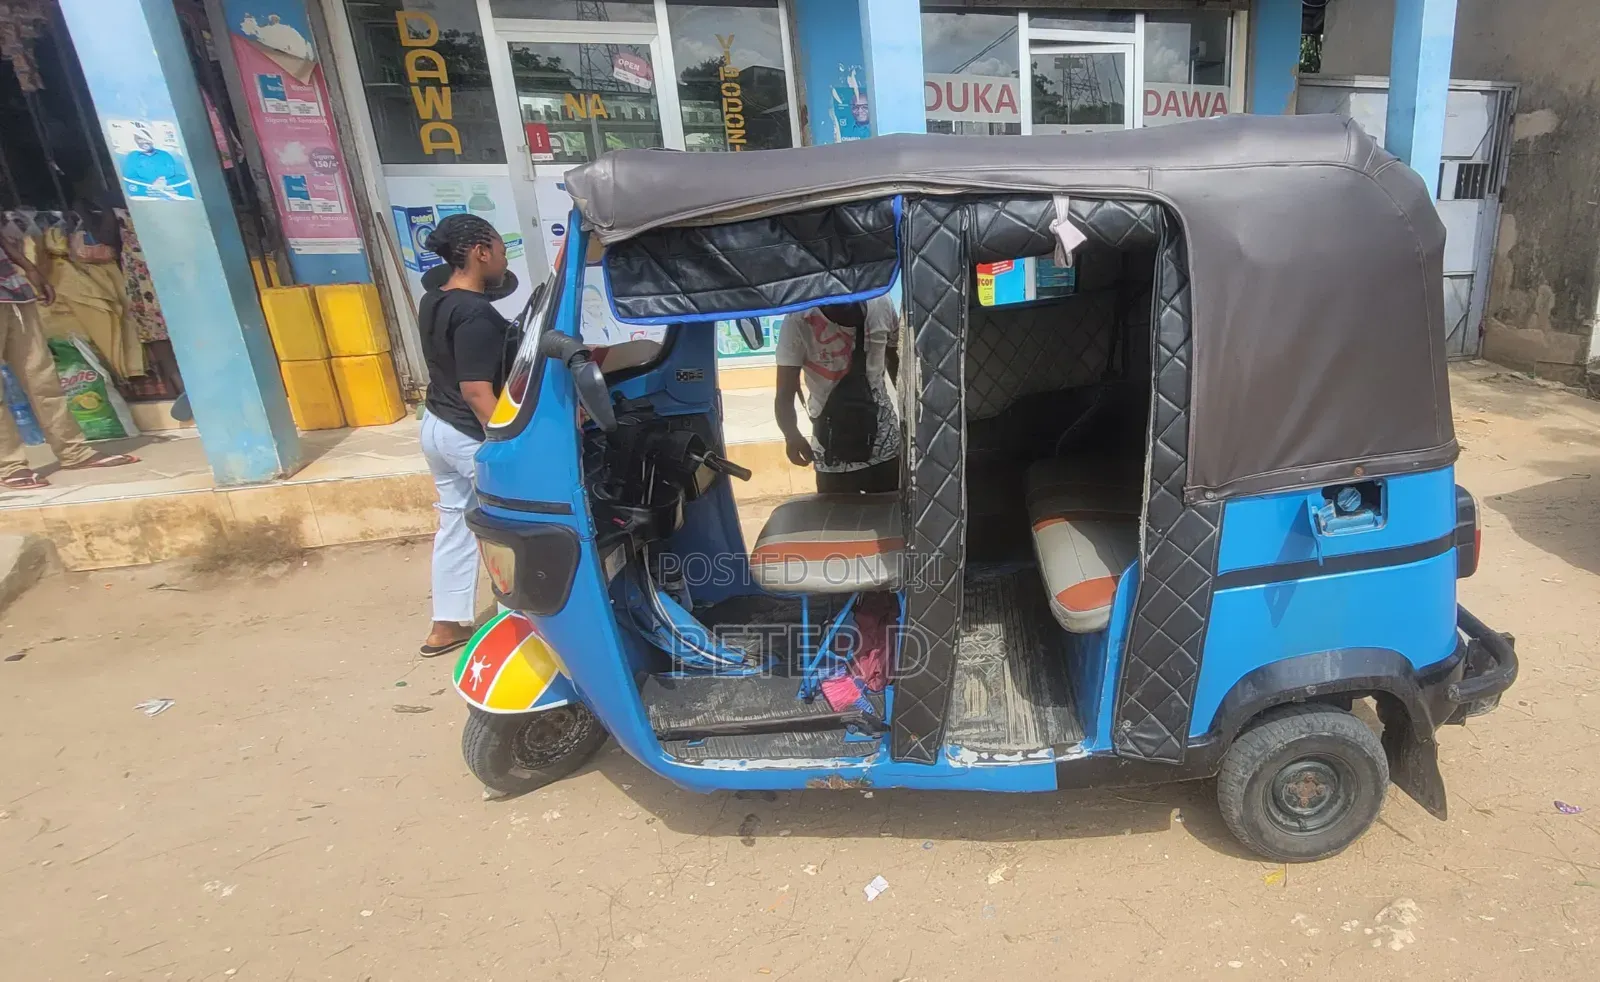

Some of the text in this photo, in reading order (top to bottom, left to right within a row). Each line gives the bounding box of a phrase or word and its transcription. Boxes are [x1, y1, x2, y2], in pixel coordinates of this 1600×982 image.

[618, 58, 640, 72] OPEN
[396, 11, 462, 155] DAWA
[564, 92, 608, 119] NA
[924, 81, 1229, 118] DUKA DAWA
[312, 153, 335, 161] Sigara
